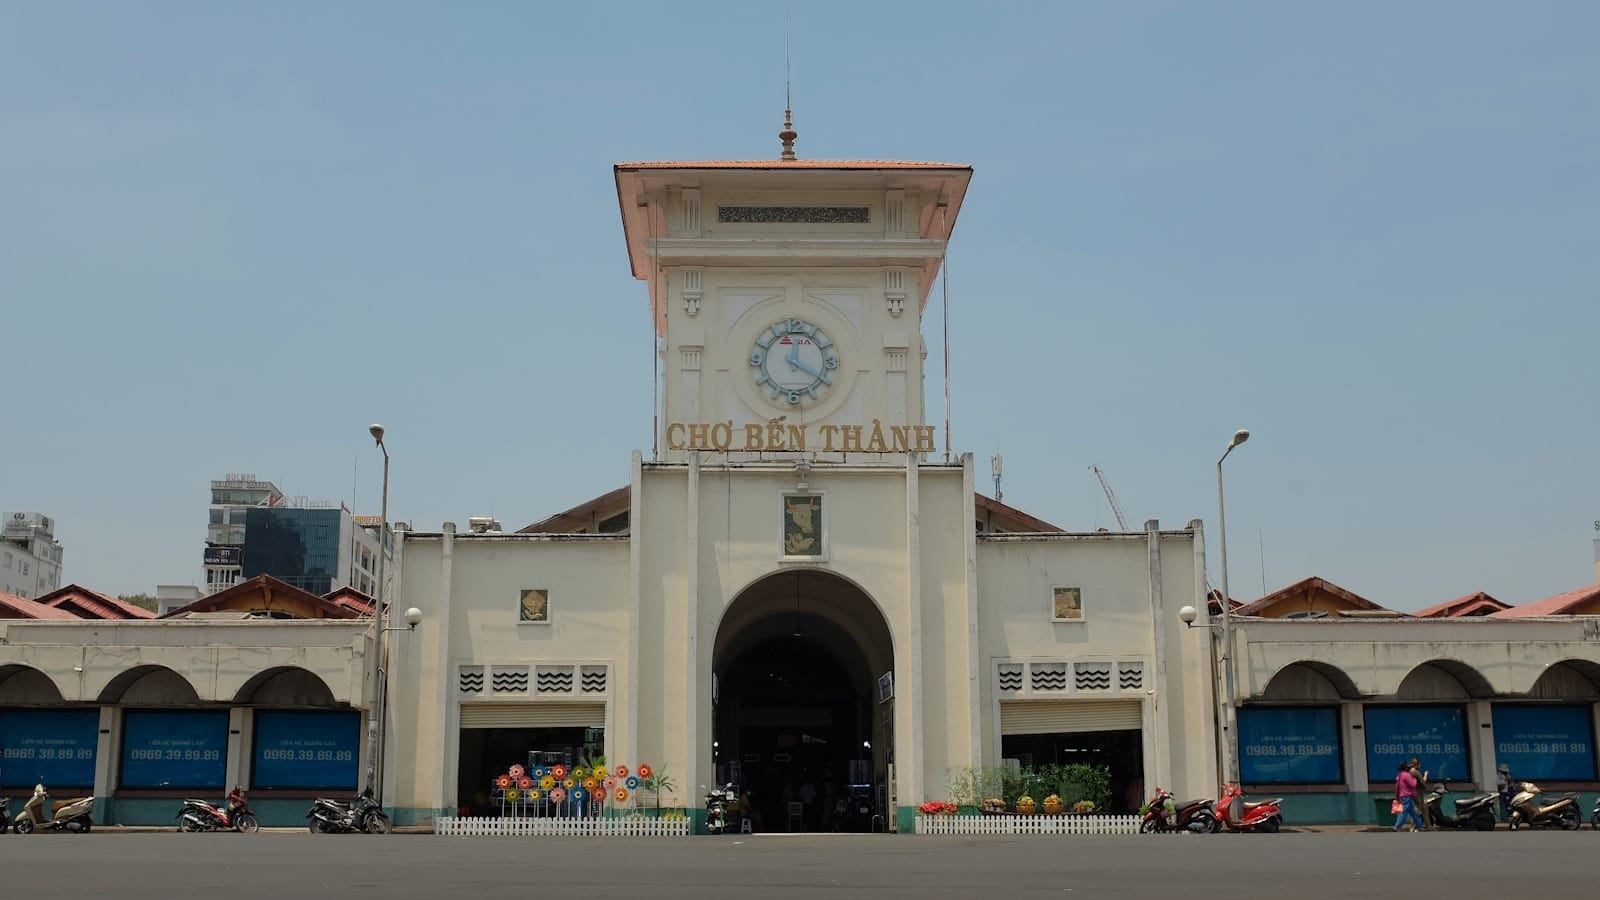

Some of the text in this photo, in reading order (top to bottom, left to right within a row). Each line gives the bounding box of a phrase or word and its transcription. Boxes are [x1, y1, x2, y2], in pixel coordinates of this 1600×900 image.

[784, 319, 804, 332] 12
[750, 351, 762, 366] 9
[824, 352, 838, 369] 3
[788, 391, 801, 404] 6
[666, 415, 936, 453] CHỢ BẾN THÀNH
[4, 748, 93, 759] 0969.39.89.89
[1246, 745, 1332, 756] 0969.39.89.89
[1374, 744, 1460, 754] 0969.39.89.89
[1499, 743, 1586, 753] 0969.39.89.89
[131, 749, 220, 760] 0969.39.89.89
[263, 749, 352, 761] 0969.39.89.89
